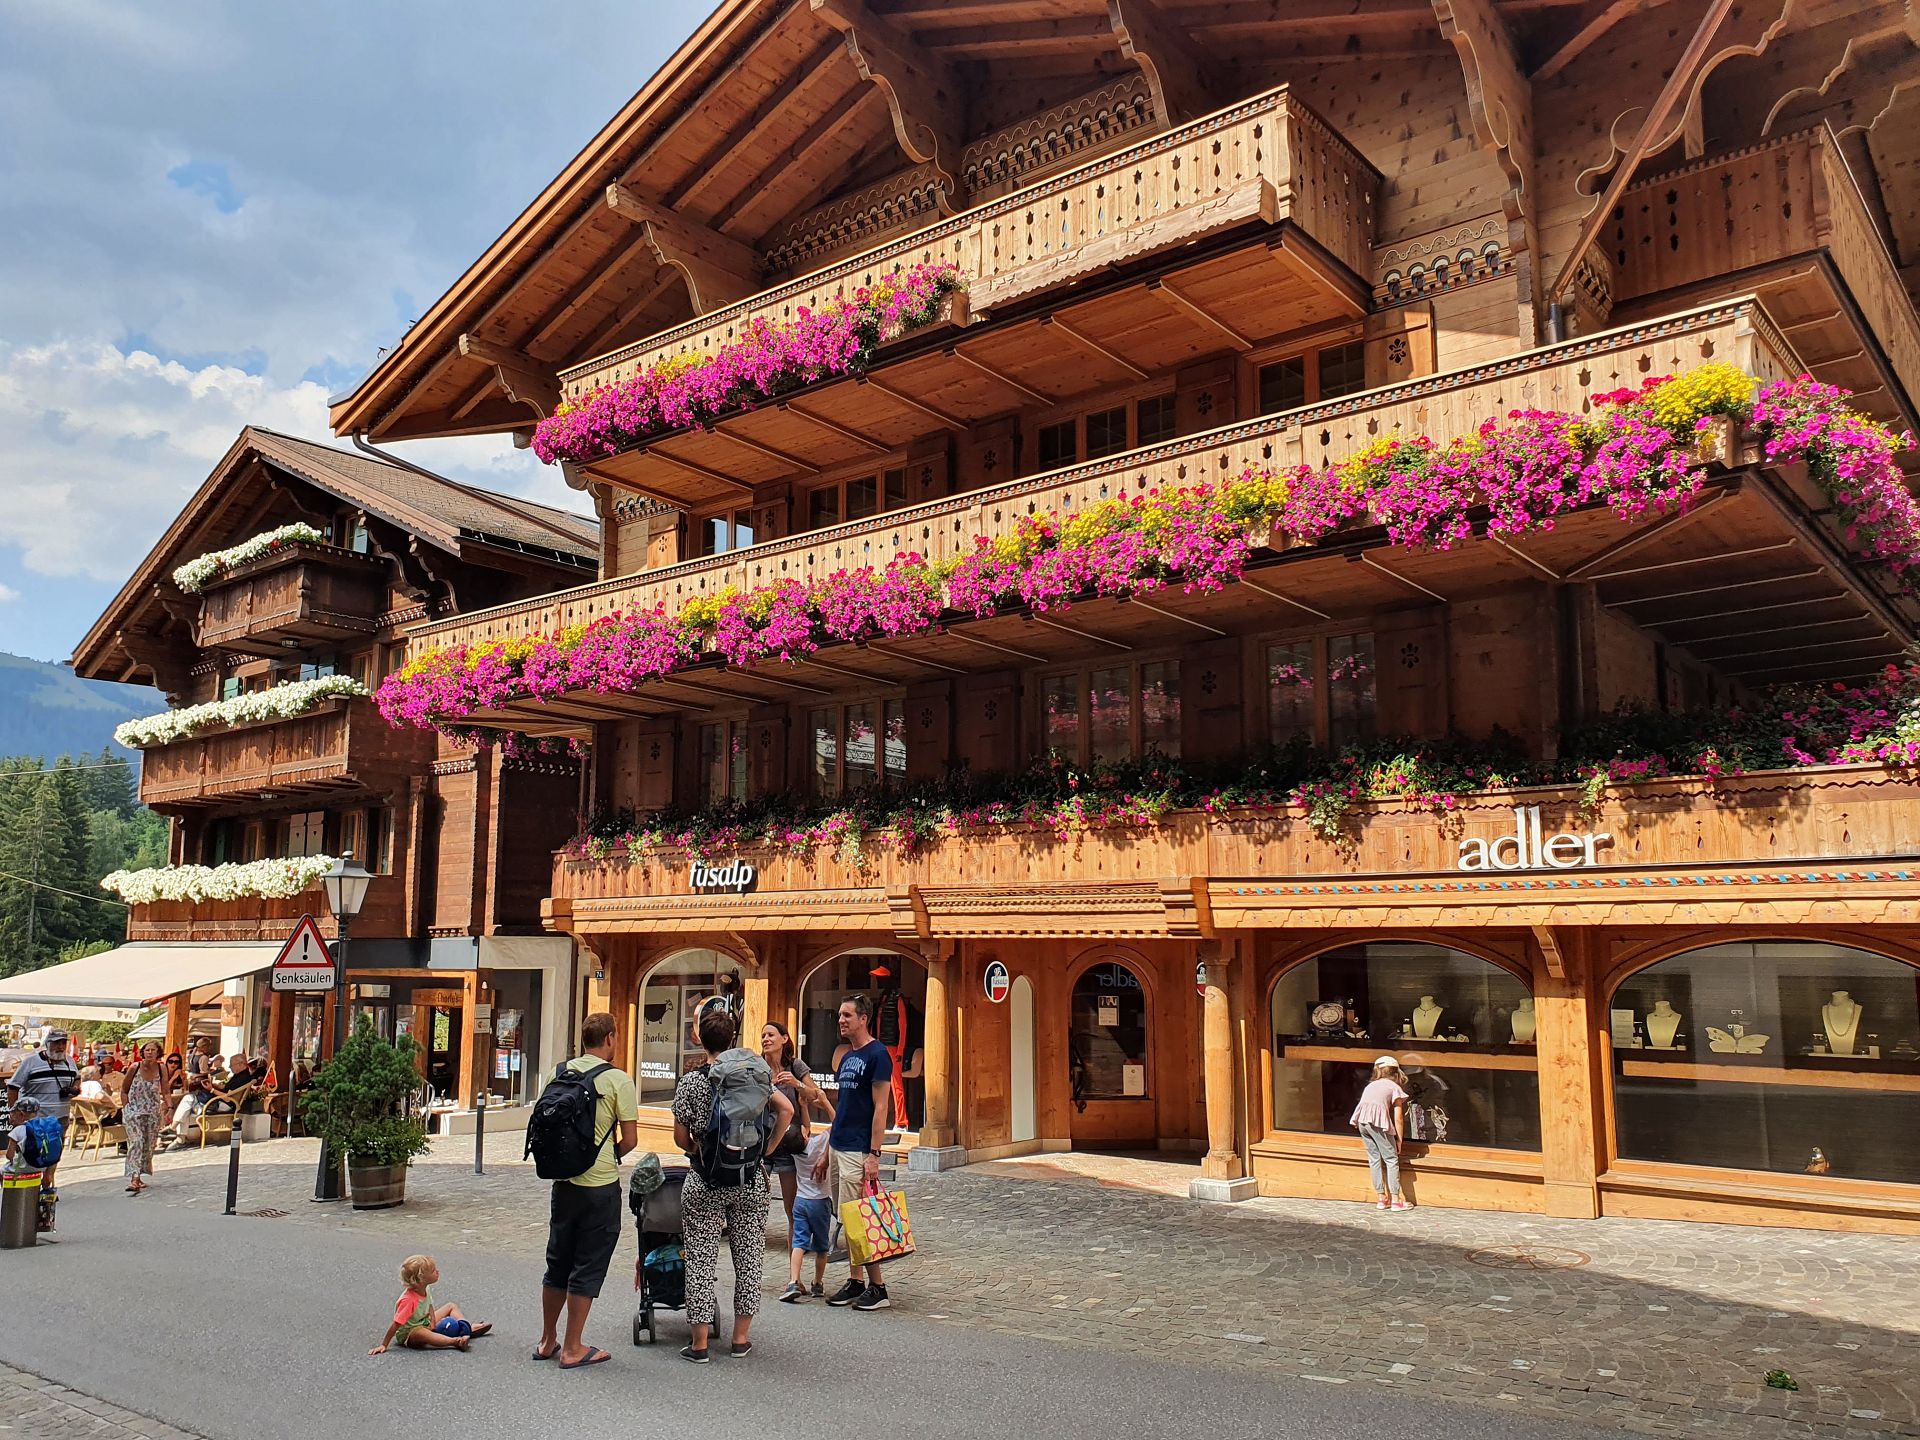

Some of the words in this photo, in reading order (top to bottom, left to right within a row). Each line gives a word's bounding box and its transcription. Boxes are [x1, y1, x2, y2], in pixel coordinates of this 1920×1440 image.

[1457, 804, 1612, 872] adler
[688, 859, 753, 892] fusalp
[275, 971, 332, 984] Senksäulen
[641, 1061, 671, 1071] NOUVELLE
[640, 1070, 677, 1080] COLLECTION
[825, 1073, 835, 1082] DE
